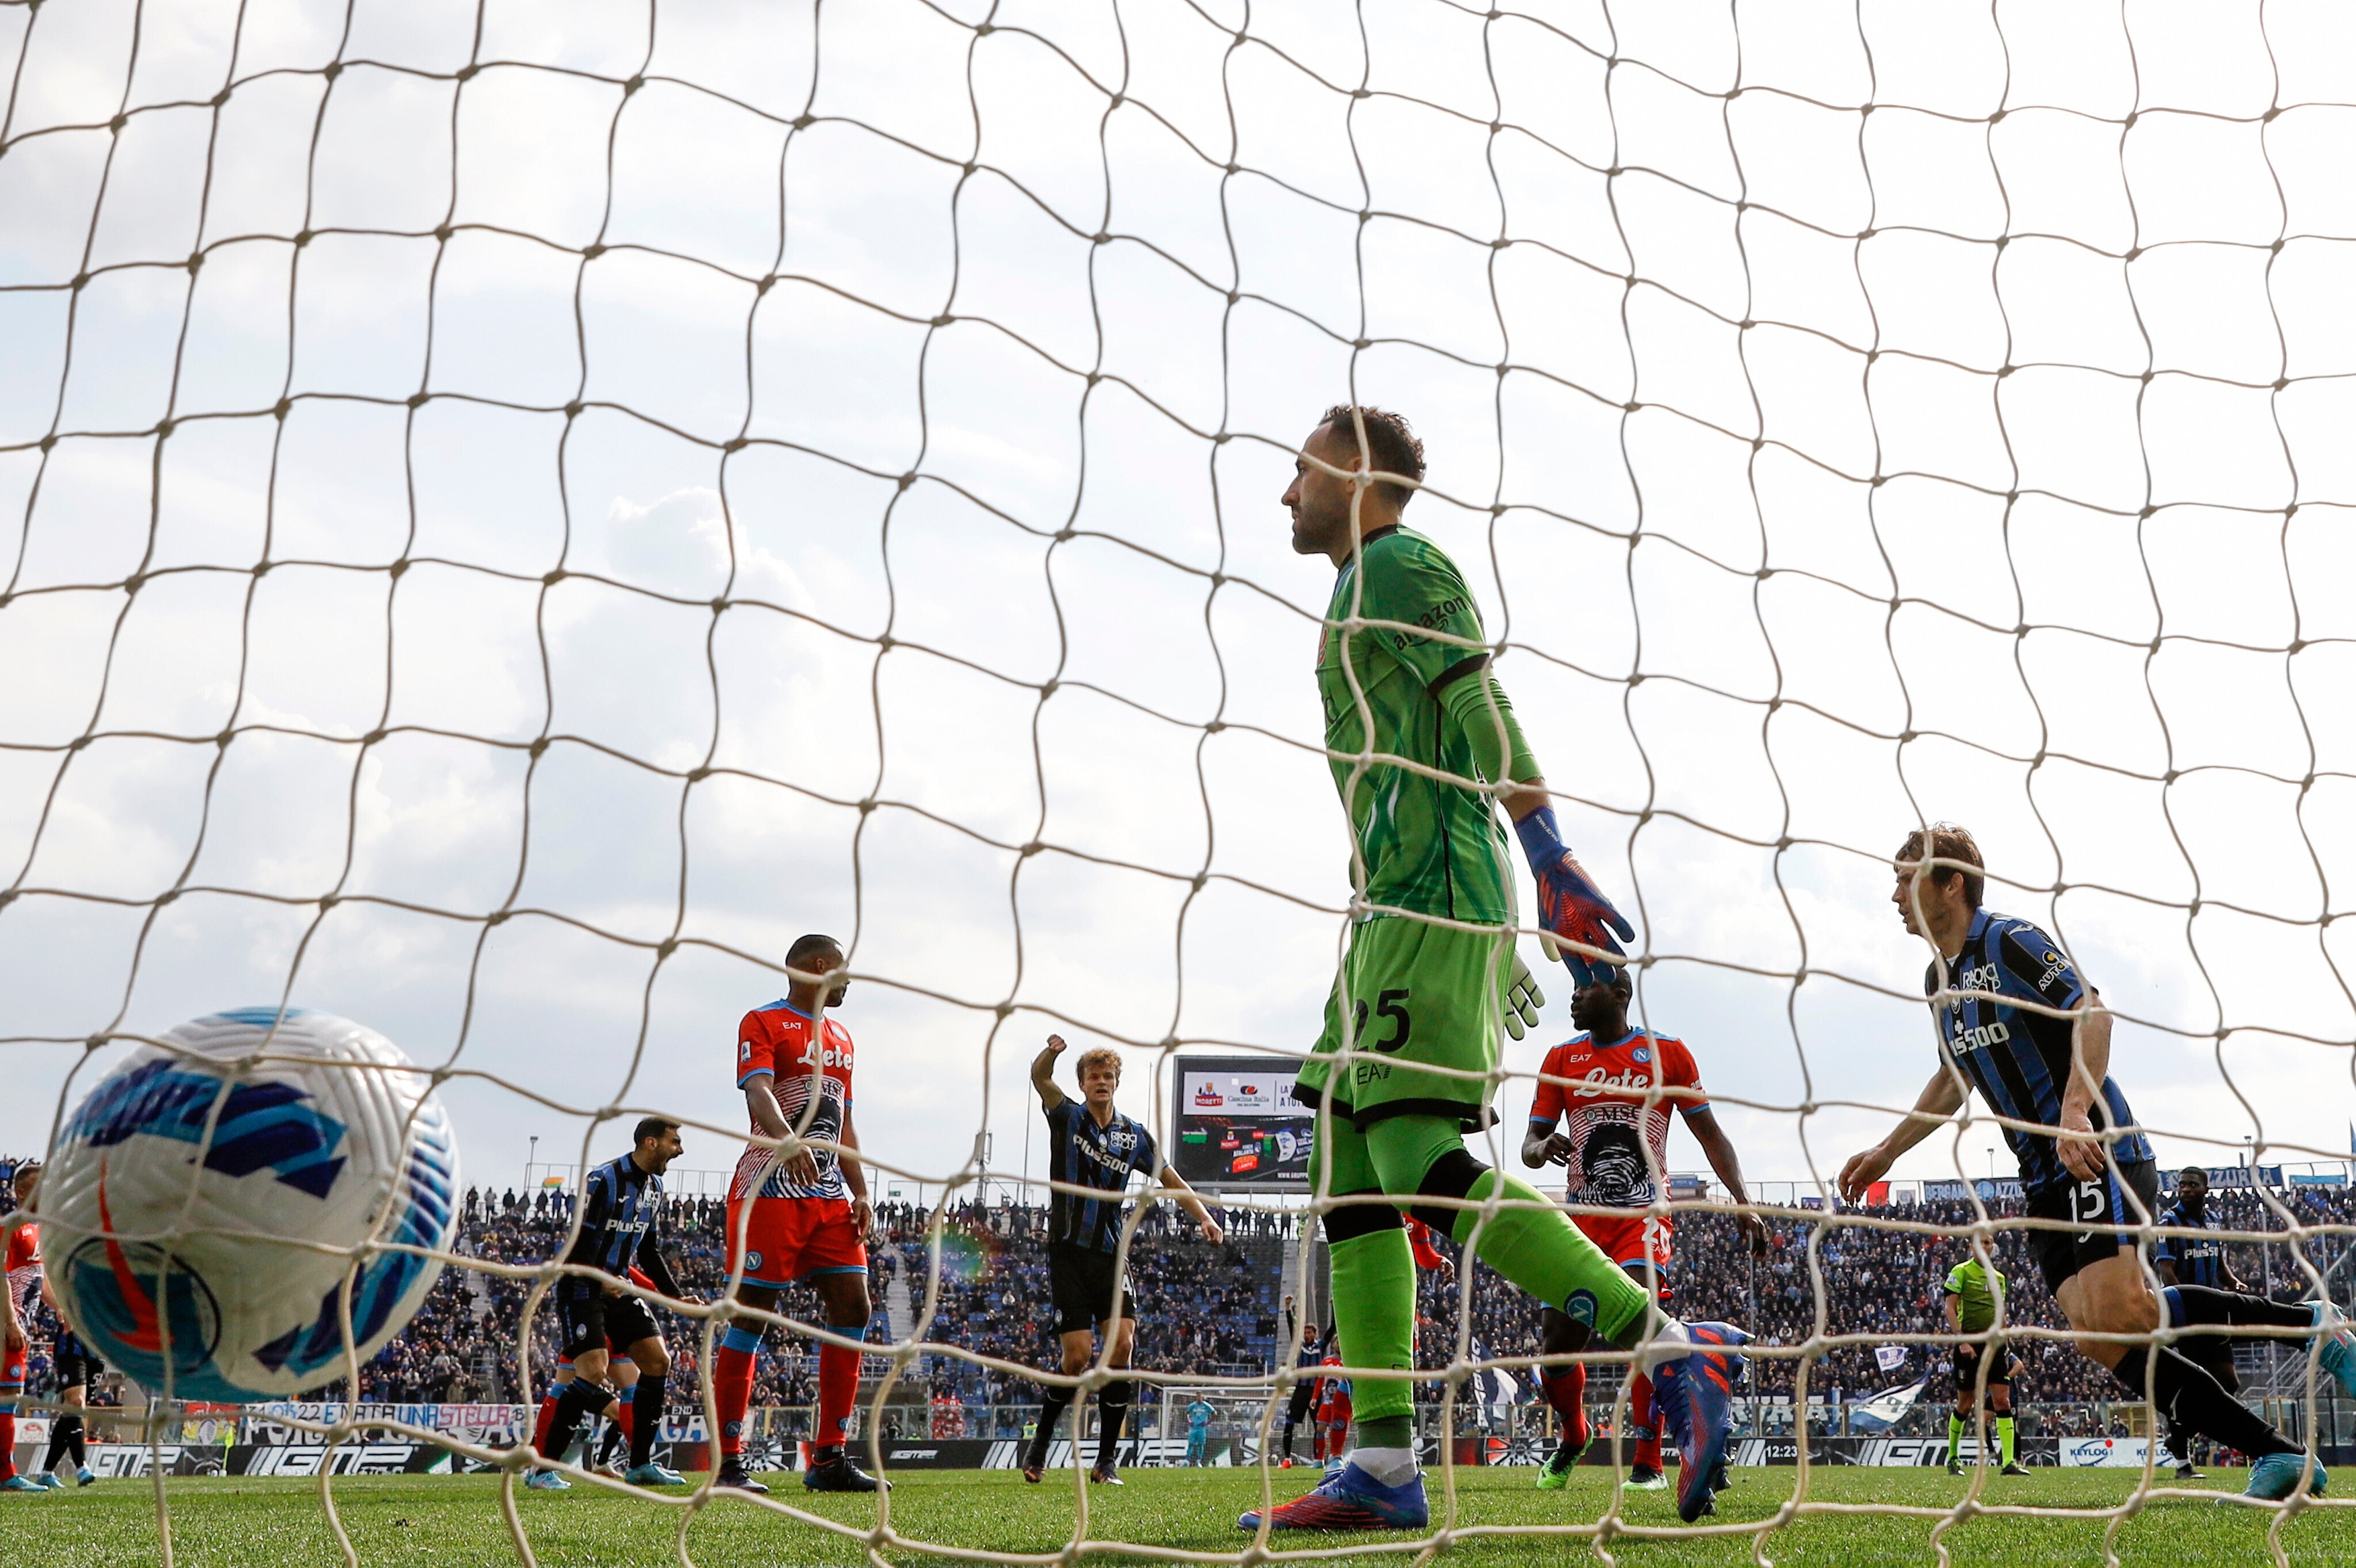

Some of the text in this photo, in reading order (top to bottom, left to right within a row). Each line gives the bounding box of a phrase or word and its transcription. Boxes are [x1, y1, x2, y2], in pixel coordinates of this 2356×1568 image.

[1962, 962, 1999, 987] RADICI
[782, 1021, 802, 1031] EA7
[797, 1039, 853, 1070] Lete
[1570, 1054, 1591, 1063] EA7
[1574, 1067, 1649, 1097] Lete
[1073, 1135, 1129, 1174] Plus500
[1925, 1184, 1969, 1201] BERGAM
[2069, 1178, 2105, 1225] 15
[439, 1405, 510, 1426] STELLA
[1765, 1445, 1798, 1458] 12:23
[2070, 1448, 2108, 1456] KEYLOG
[2136, 1448, 2174, 1456] KELO
